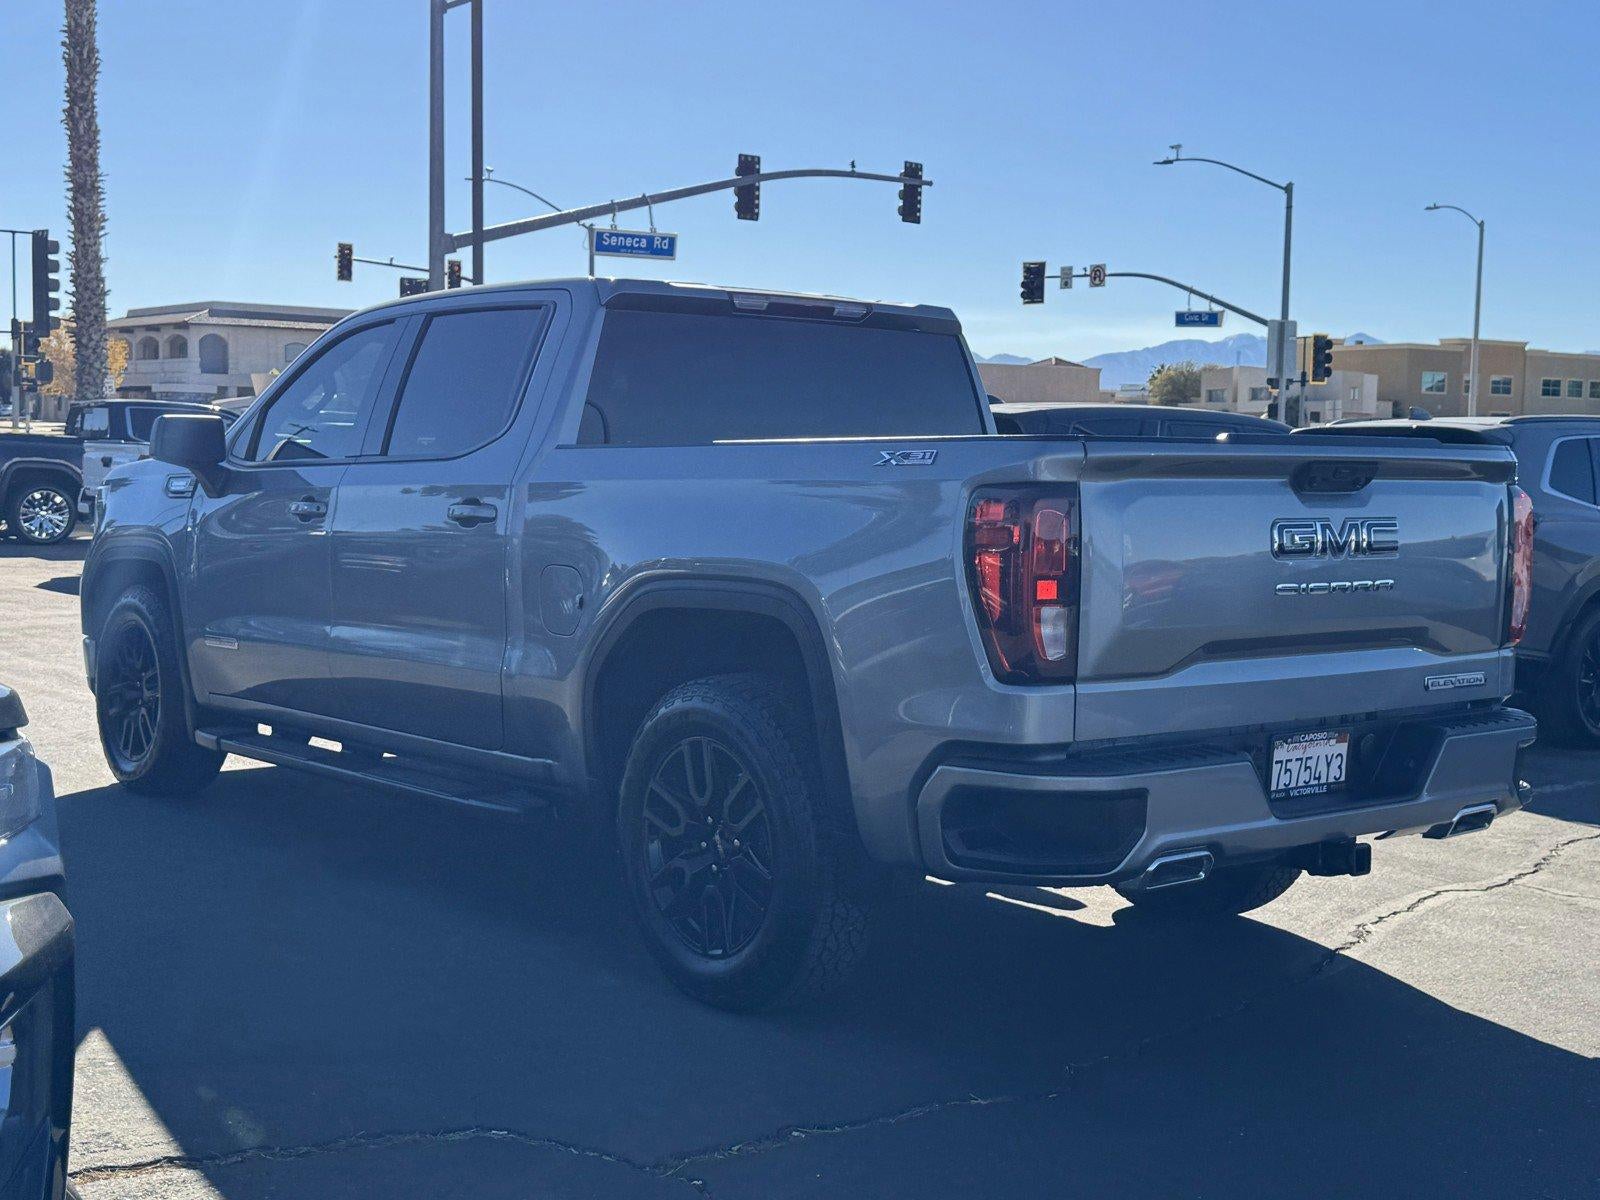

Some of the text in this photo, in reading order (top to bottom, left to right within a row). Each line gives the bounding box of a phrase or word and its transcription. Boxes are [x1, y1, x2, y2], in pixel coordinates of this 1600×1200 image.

[602, 232, 669, 250] Seneca Rd
[1270, 517, 1399, 561] GMC
[1275, 579, 1395, 595] SIERRA
[1430, 676, 1484, 687] ELEVATION
[1300, 732, 1328, 742] CAPOSIO
[1275, 752, 1344, 791] 75754Y3
[1289, 785, 1328, 797] VICTORVILLE
